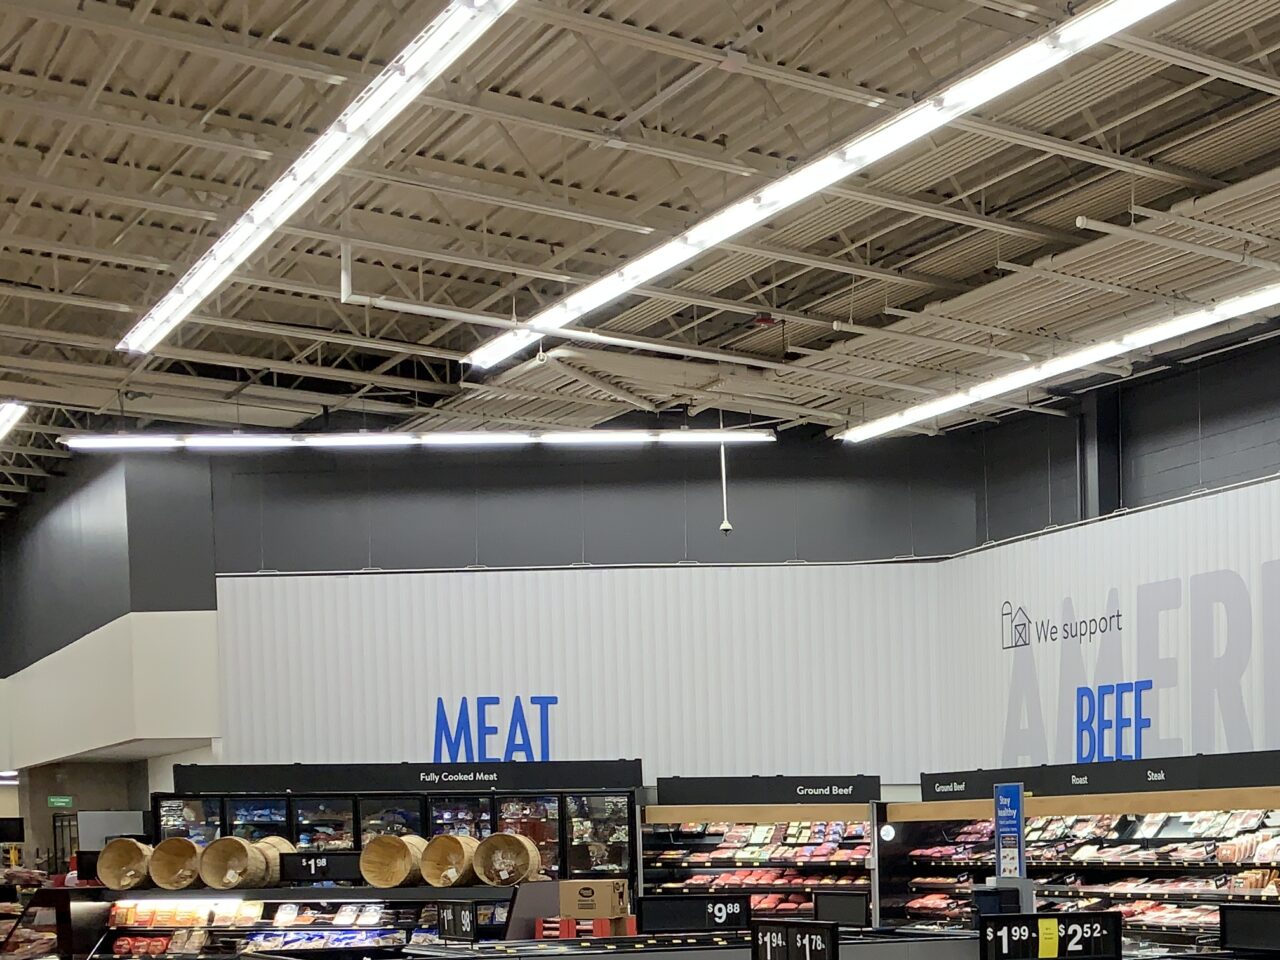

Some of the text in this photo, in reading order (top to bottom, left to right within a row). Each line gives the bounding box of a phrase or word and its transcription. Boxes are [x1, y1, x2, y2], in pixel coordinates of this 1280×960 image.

[1035, 609, 1123, 644] We support
[1076, 679, 1153, 764] BEEF
[433, 695, 558, 763] MEAT
[420, 772, 498, 783] Fully Cooked Meat
[1071, 775, 1088, 784] Roast
[1147, 770, 1165, 781] Steak
[796, 785, 853, 795] Ground Beef
[935, 782, 966, 792] Ground Beef
